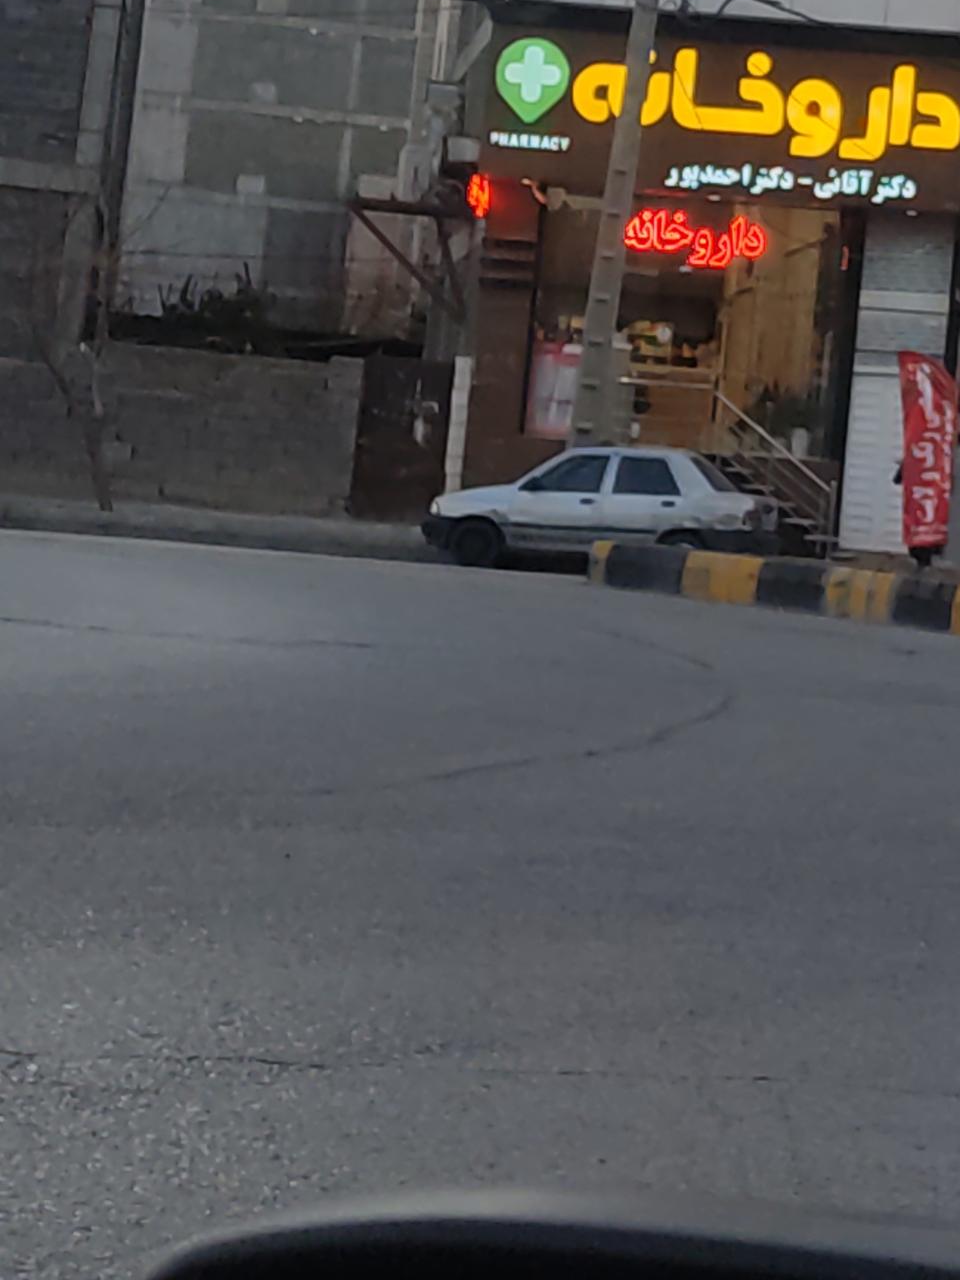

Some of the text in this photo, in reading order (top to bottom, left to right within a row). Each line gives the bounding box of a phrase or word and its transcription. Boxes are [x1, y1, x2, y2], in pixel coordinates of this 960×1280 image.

[750, 166, 794, 195] دکتر
[871, 174, 917, 204] دکتر
[624, 208, 766, 269] داروخانه
